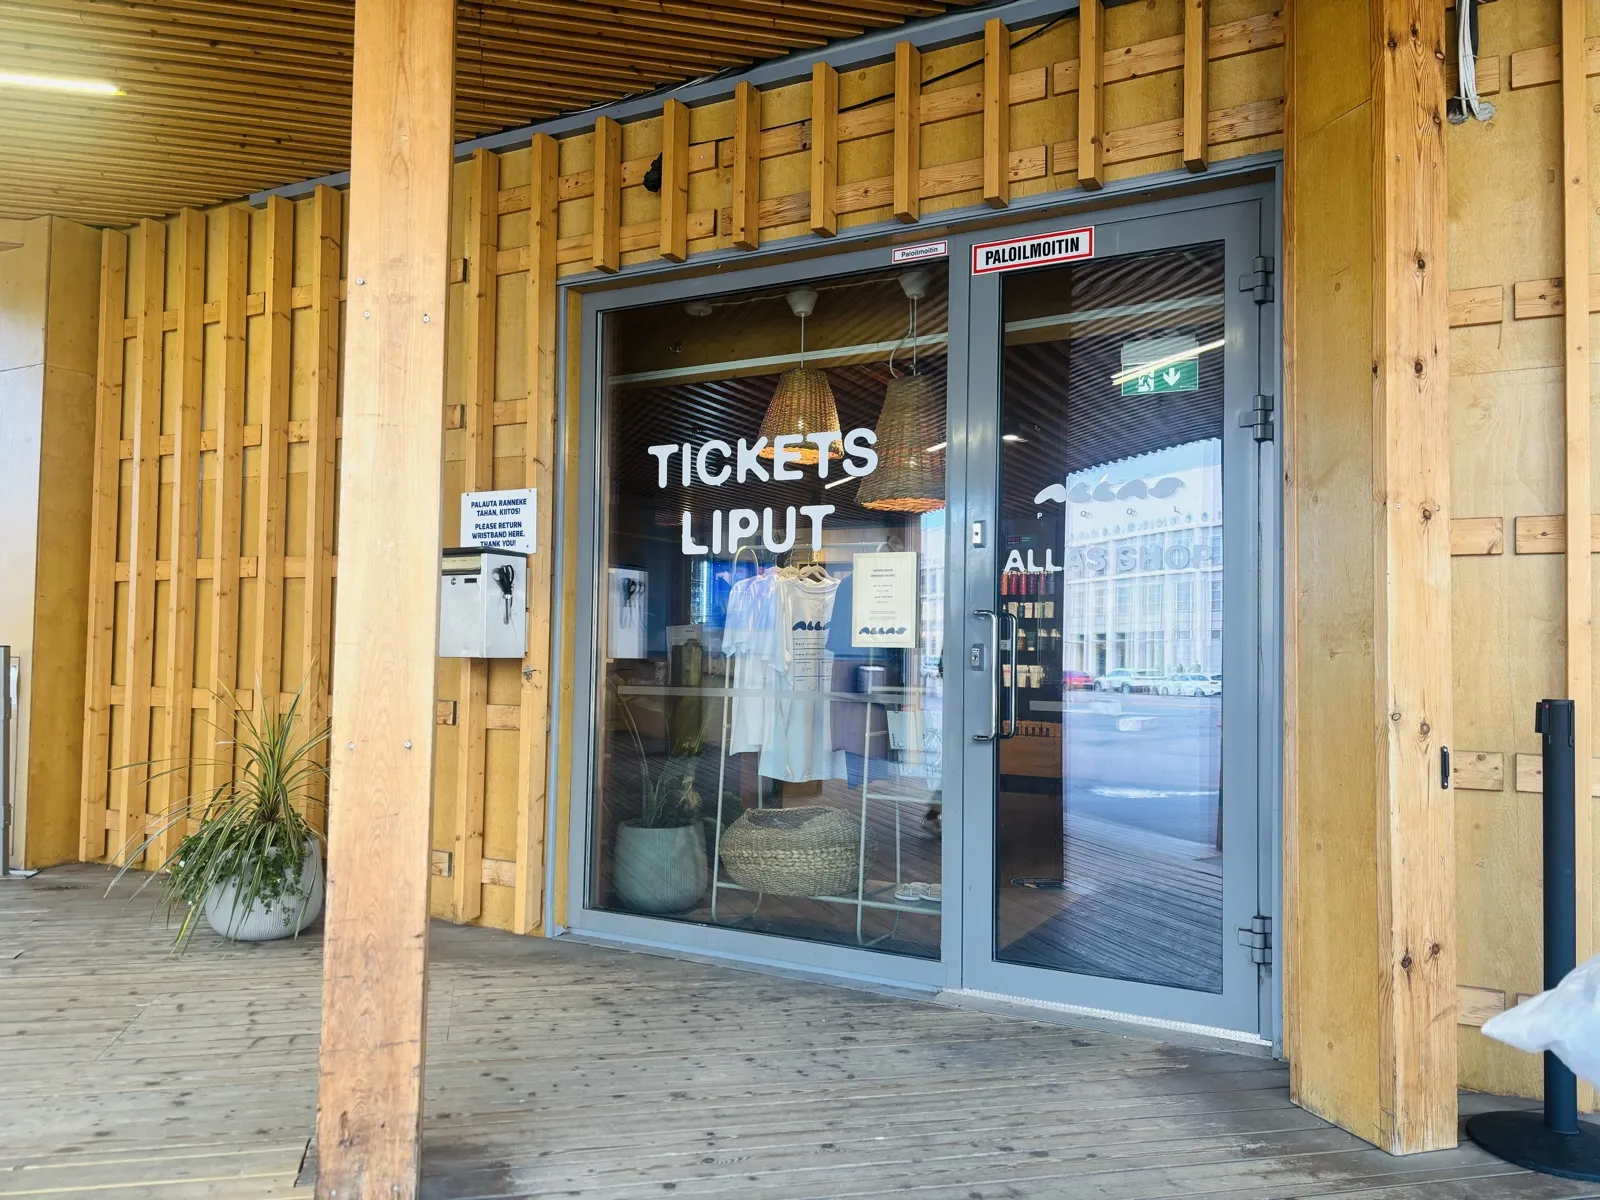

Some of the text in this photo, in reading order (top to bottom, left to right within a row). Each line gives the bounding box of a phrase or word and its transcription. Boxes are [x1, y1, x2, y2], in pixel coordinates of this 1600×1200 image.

[901, 247, 939, 258] Paloilmoitin
[985, 237, 1080, 266] PALOILMOITIN
[648, 427, 878, 489] TICKETS
[471, 498, 527, 508] PALAUTA RANNEKE
[500, 508, 520, 516] KIITOS!
[498, 521, 522, 529] RETURN
[681, 505, 836, 556] LIPUT
[472, 531, 507, 540] WRISTBAND
[1003, 545, 1213, 573] ALLAS SHOP
